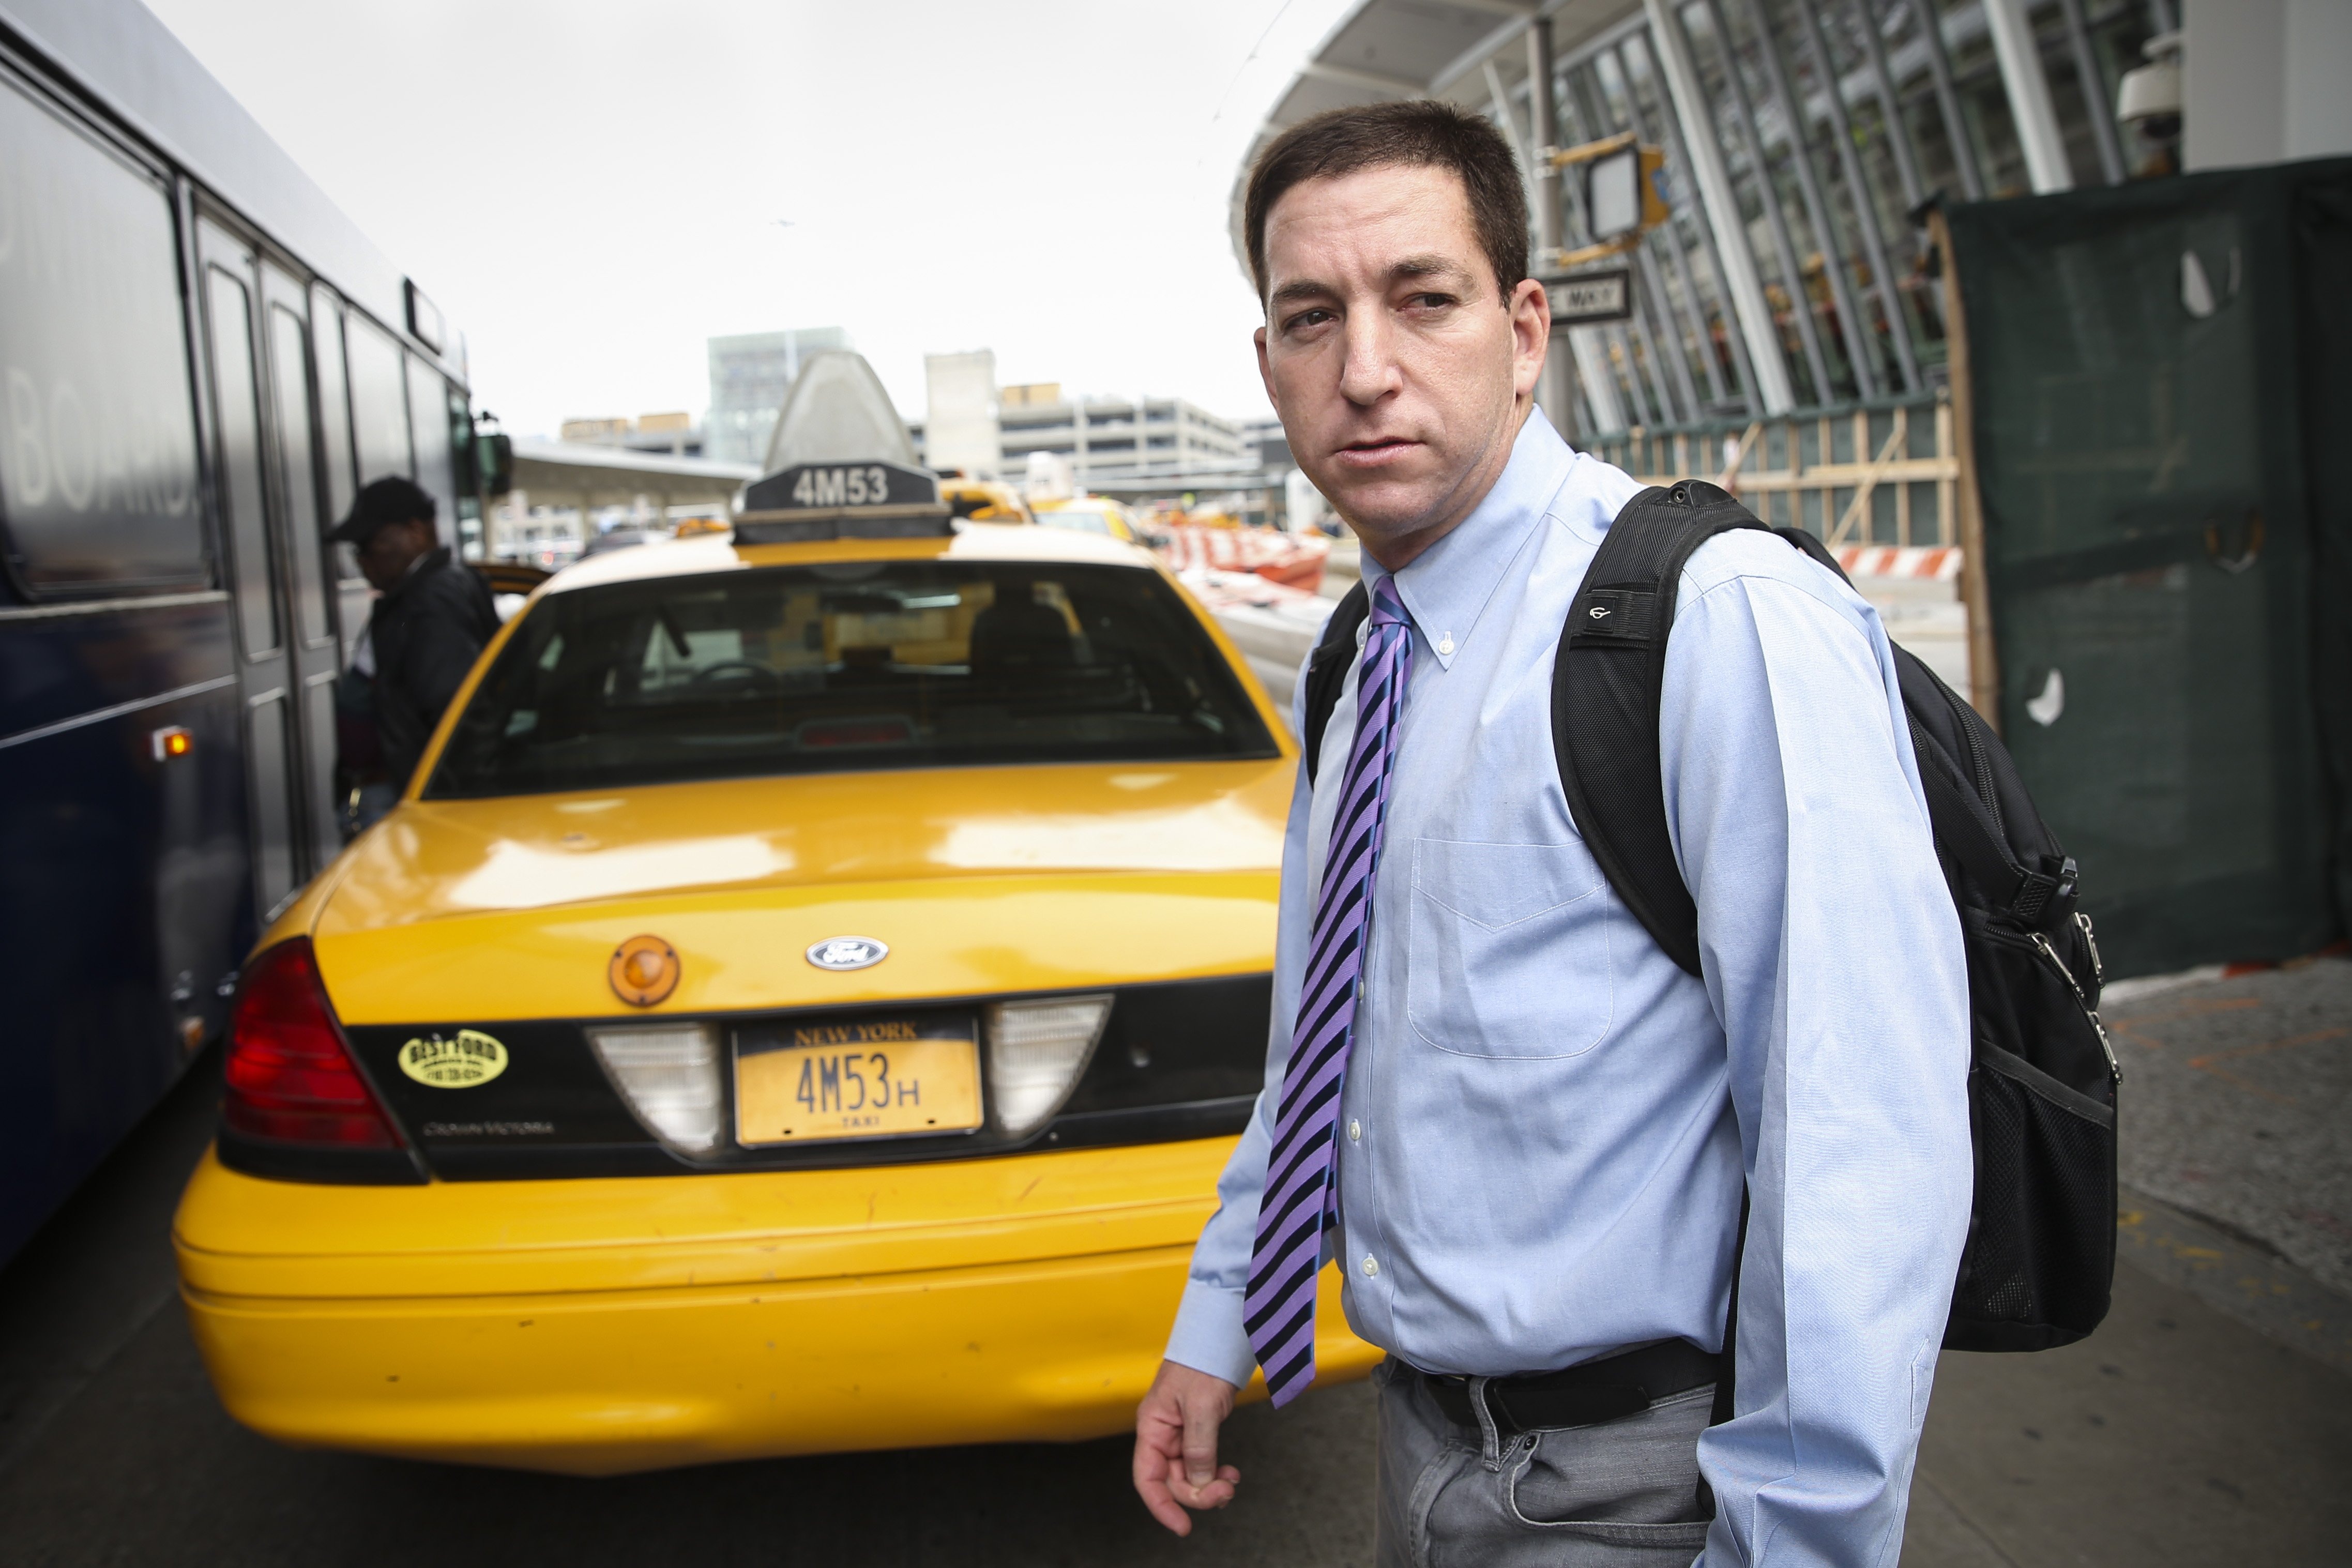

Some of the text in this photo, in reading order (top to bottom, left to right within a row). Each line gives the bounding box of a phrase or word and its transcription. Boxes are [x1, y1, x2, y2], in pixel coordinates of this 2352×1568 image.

[793, 466, 889, 506] 4M53
[823, 941, 869, 963] Ford
[794, 1021, 918, 1047] NEW YORK
[842, 1116, 880, 1128] TAXI
